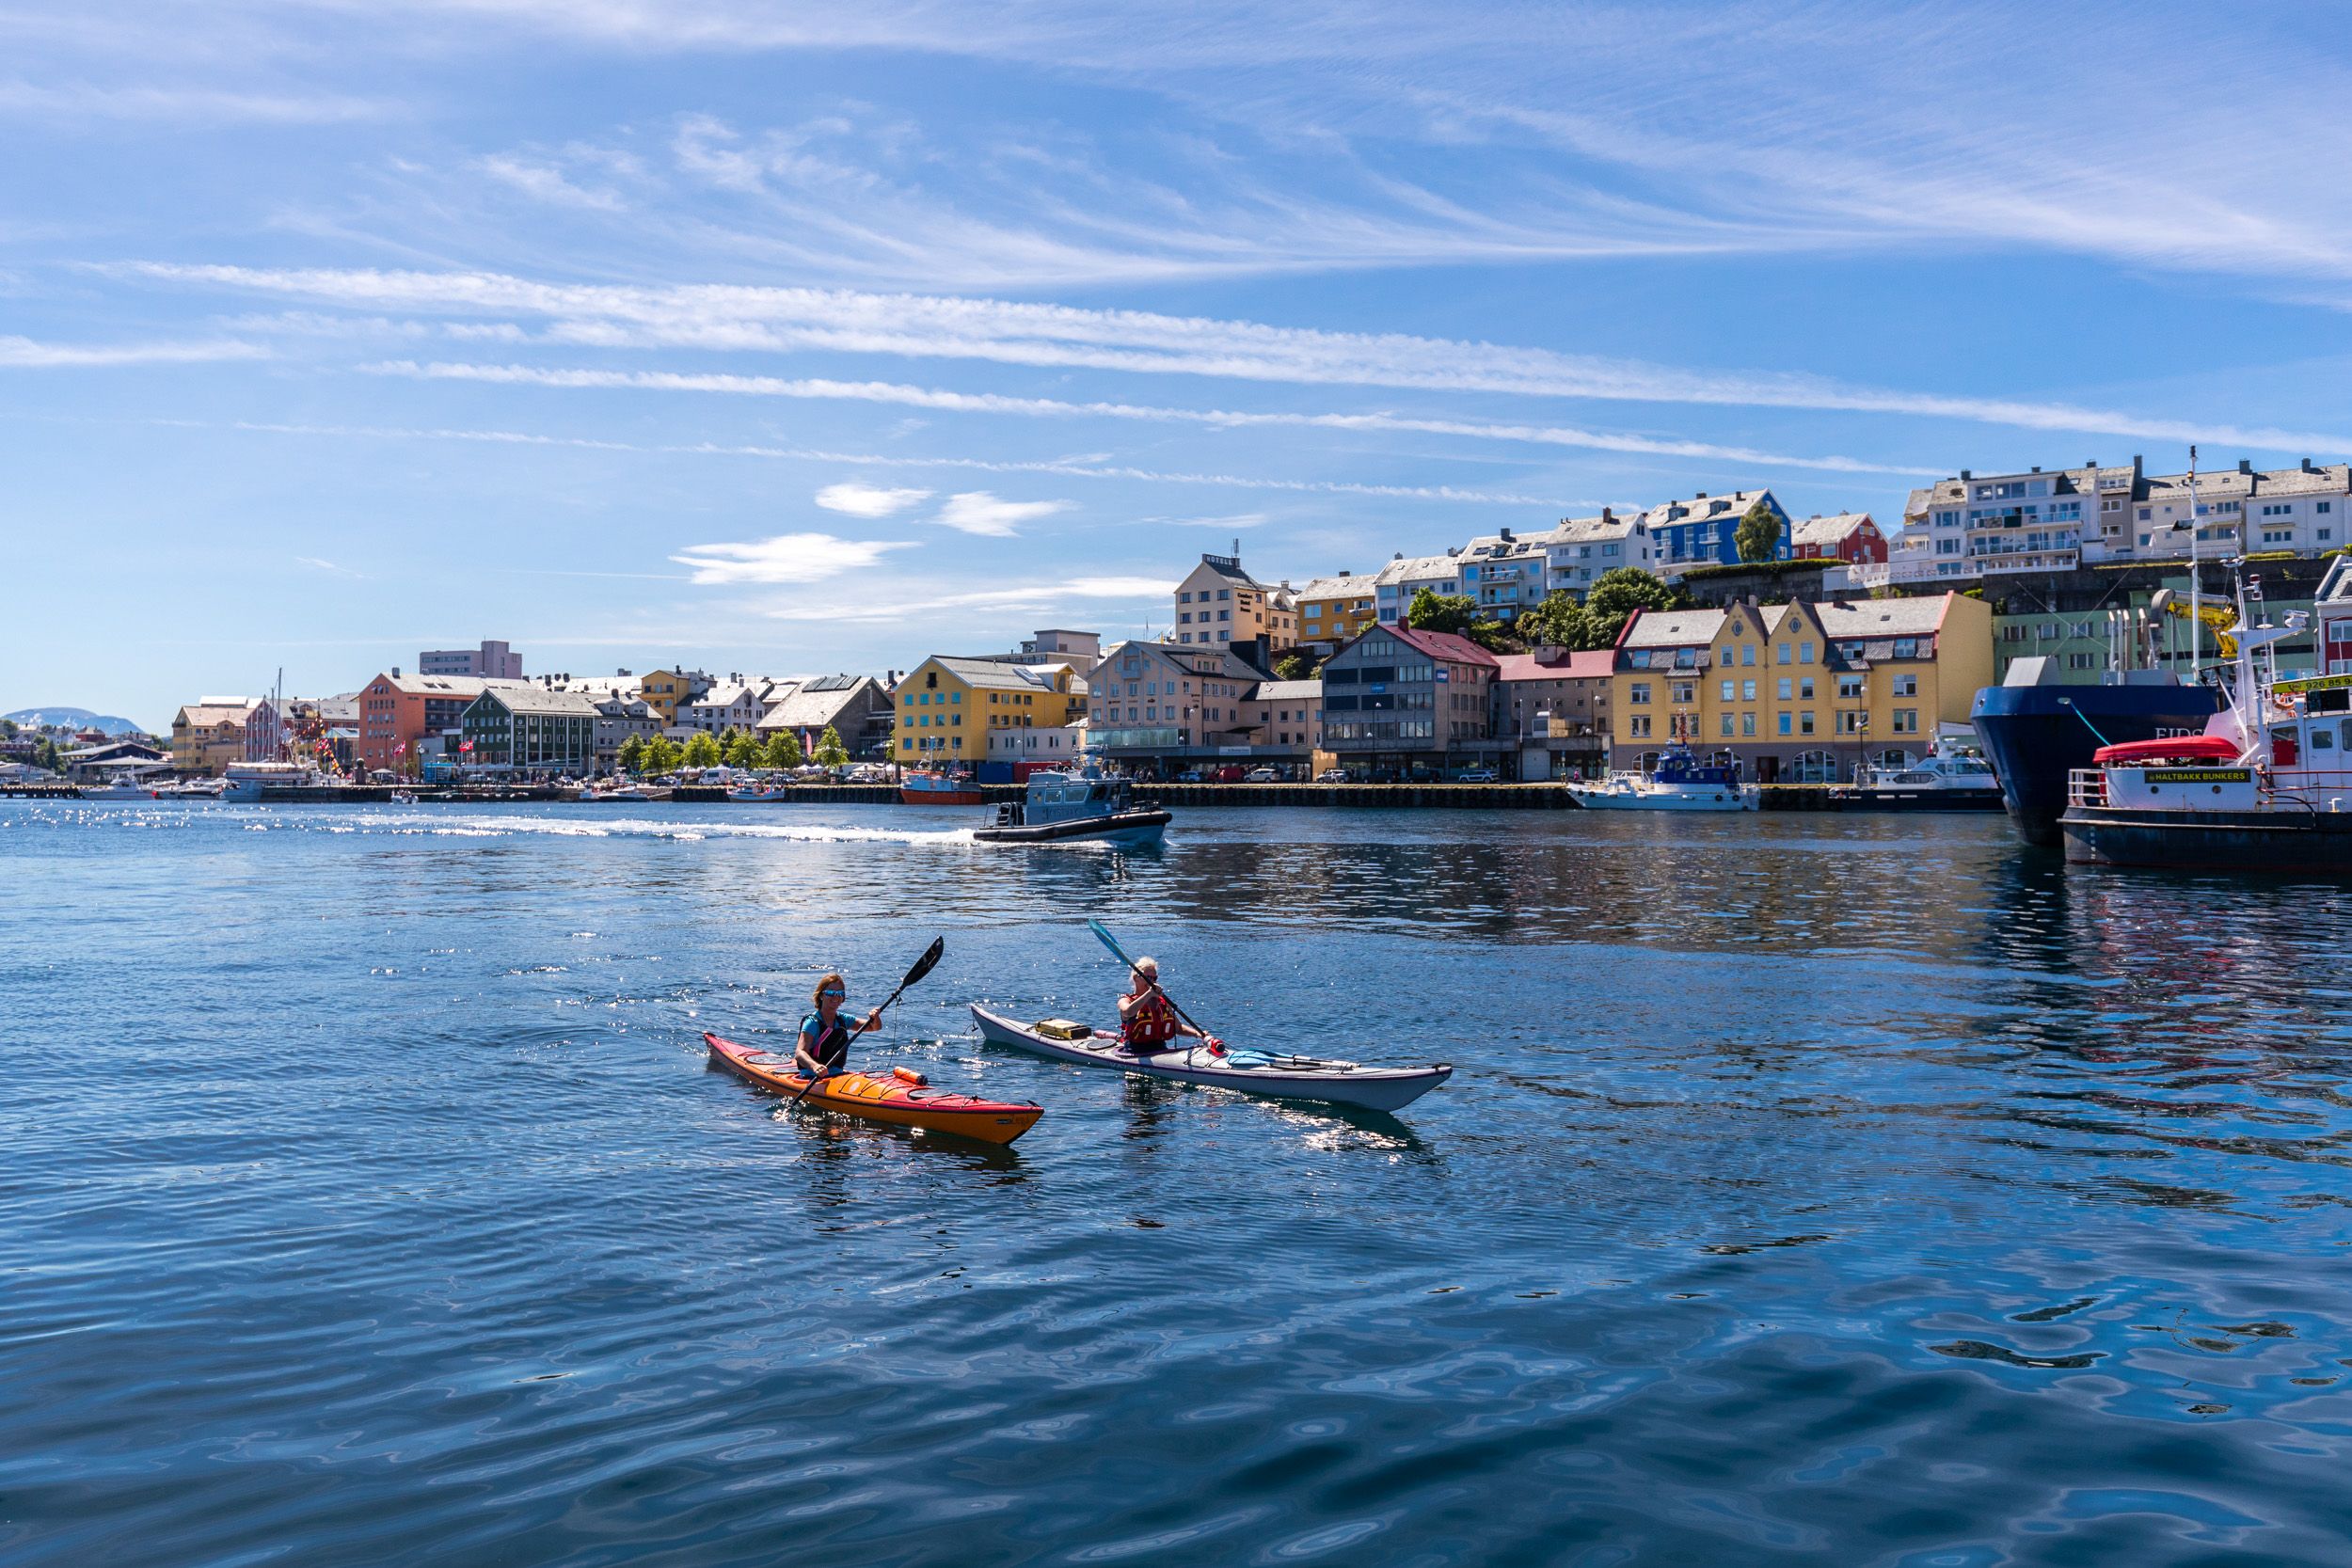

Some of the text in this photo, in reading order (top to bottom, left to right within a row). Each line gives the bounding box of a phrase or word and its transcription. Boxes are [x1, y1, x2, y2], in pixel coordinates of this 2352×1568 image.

[1206, 556, 1232, 565] HOTELL
[2306, 680, 2325, 689] 926
[2154, 727, 2205, 740] EIDS
